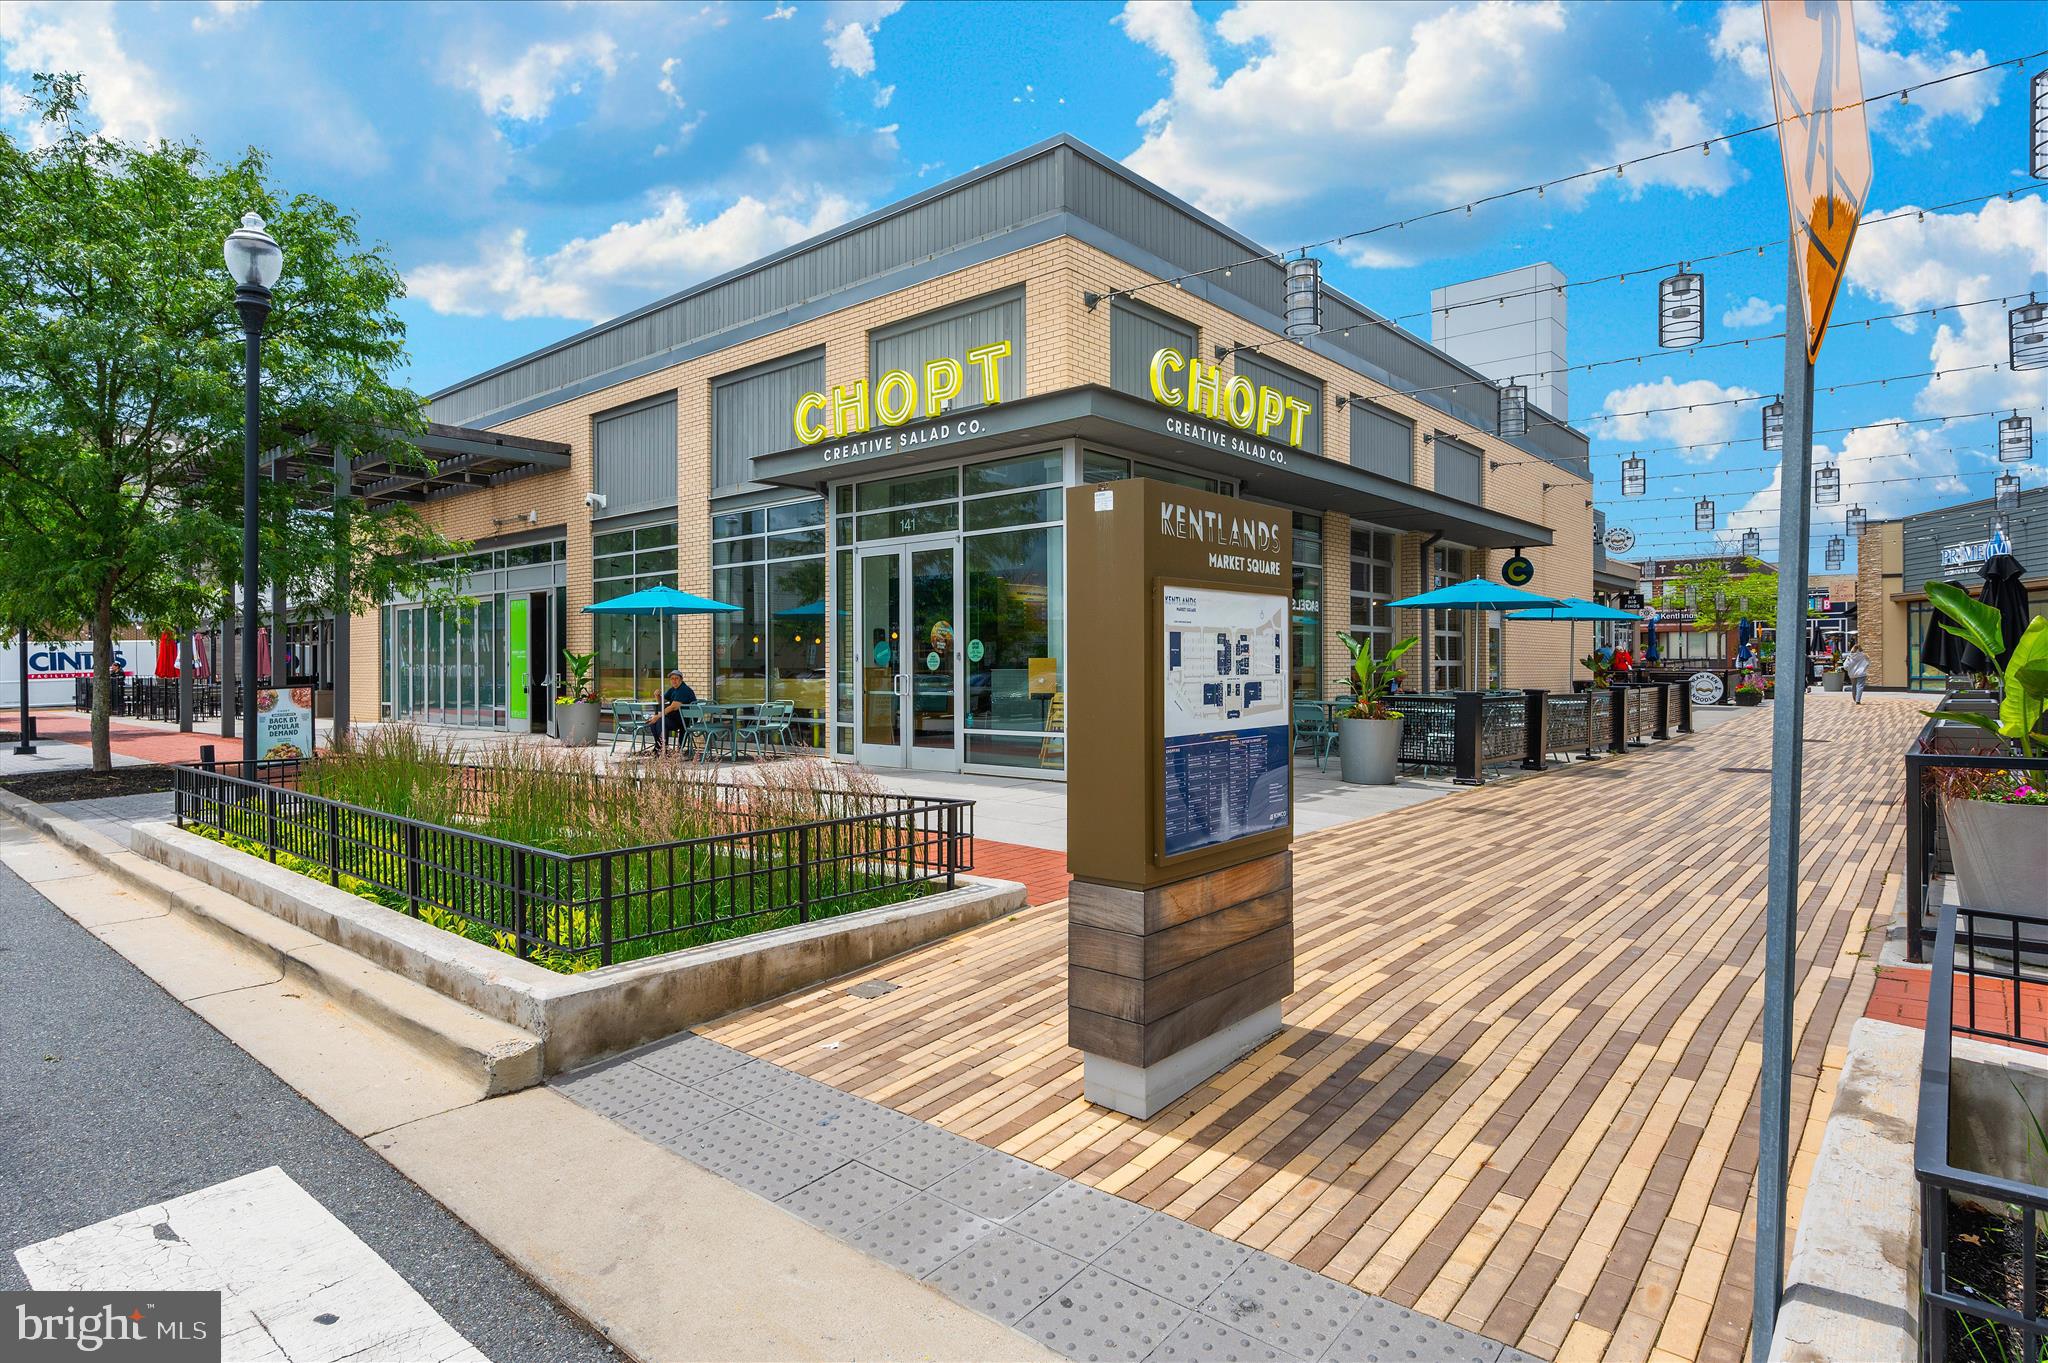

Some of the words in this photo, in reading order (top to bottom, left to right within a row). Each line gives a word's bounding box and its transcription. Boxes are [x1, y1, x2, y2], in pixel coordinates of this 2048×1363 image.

[794, 340, 1011, 445] CHOPT
[1150, 347, 1312, 449] CHOPT
[823, 436, 892, 462] CREATIVE
[900, 425, 950, 447] SALAD
[957, 419, 986, 436] CO.
[1166, 417, 1226, 447] CREATIVE
[1231, 437, 1266, 459] SALAD
[1269, 450, 1287, 464] CO.
[900, 518, 916, 533] 141
[1161, 501, 1281, 554] KENTLANDS
[1608, 543, 1629, 551] NOODLE
[1208, 552, 1245, 571] MARKET
[1247, 558, 1281, 576] SQUARE
[1508, 561, 1527, 582] C
[29, 645, 127, 672] CINTS
[1691, 693, 1718, 702] NOODLE
[268, 723, 300, 731] POPULAR
[269, 729, 299, 737] DEMAND
